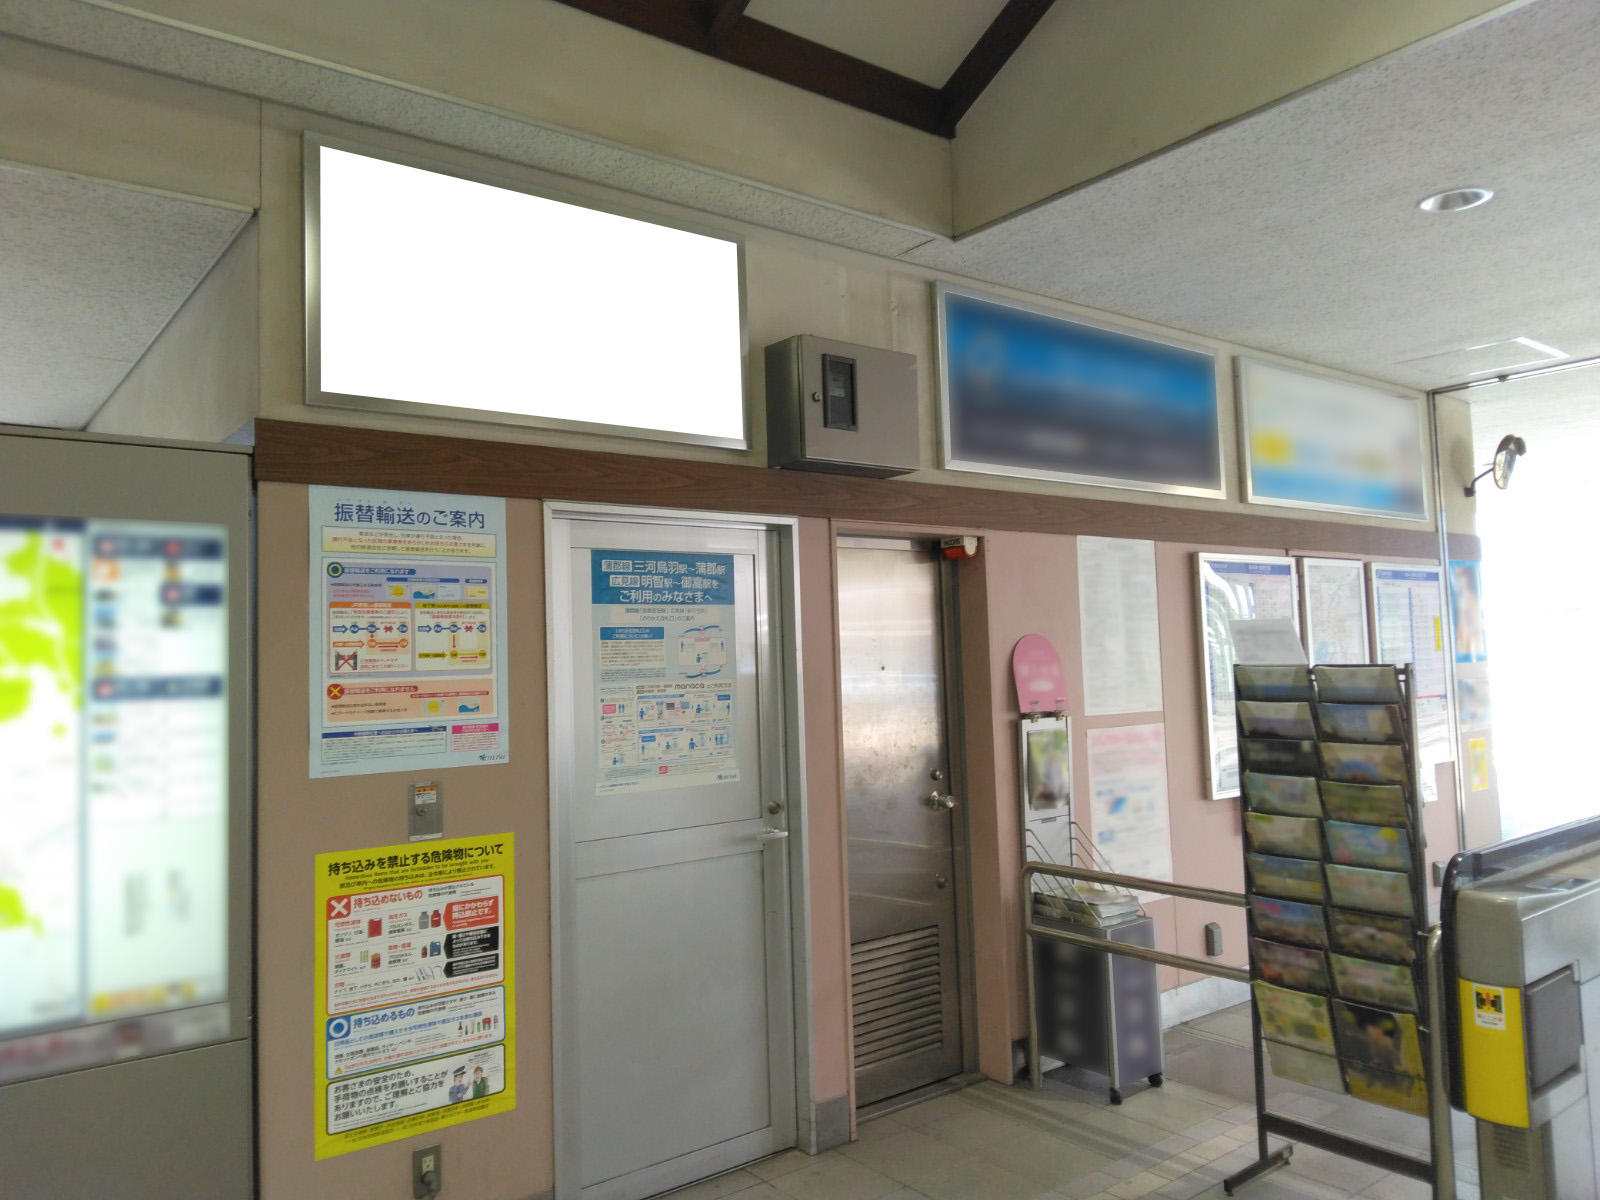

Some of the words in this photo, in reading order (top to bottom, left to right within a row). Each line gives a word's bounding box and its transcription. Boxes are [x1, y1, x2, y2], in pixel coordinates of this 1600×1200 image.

[334, 503, 485, 529] 振替輸送のご案内
[611, 576, 640, 587] 広見線
[620, 590, 713, 604] ご利用のみなさまへ
[328, 844, 504, 876] 持ち込みを禁止する危険物について
[354, 889, 423, 908] 持ち込めないもの
[354, 1008, 415, 1029] 持ち込めるもの
[334, 1070, 415, 1094] お客さまの安全のため、
[334, 1070, 448, 1103] 手荷物の点検をお願いすることが
[334, 1081, 445, 1112] ありますので、ご理解とご協力を
[334, 1101, 398, 1121] お願いいたします。
